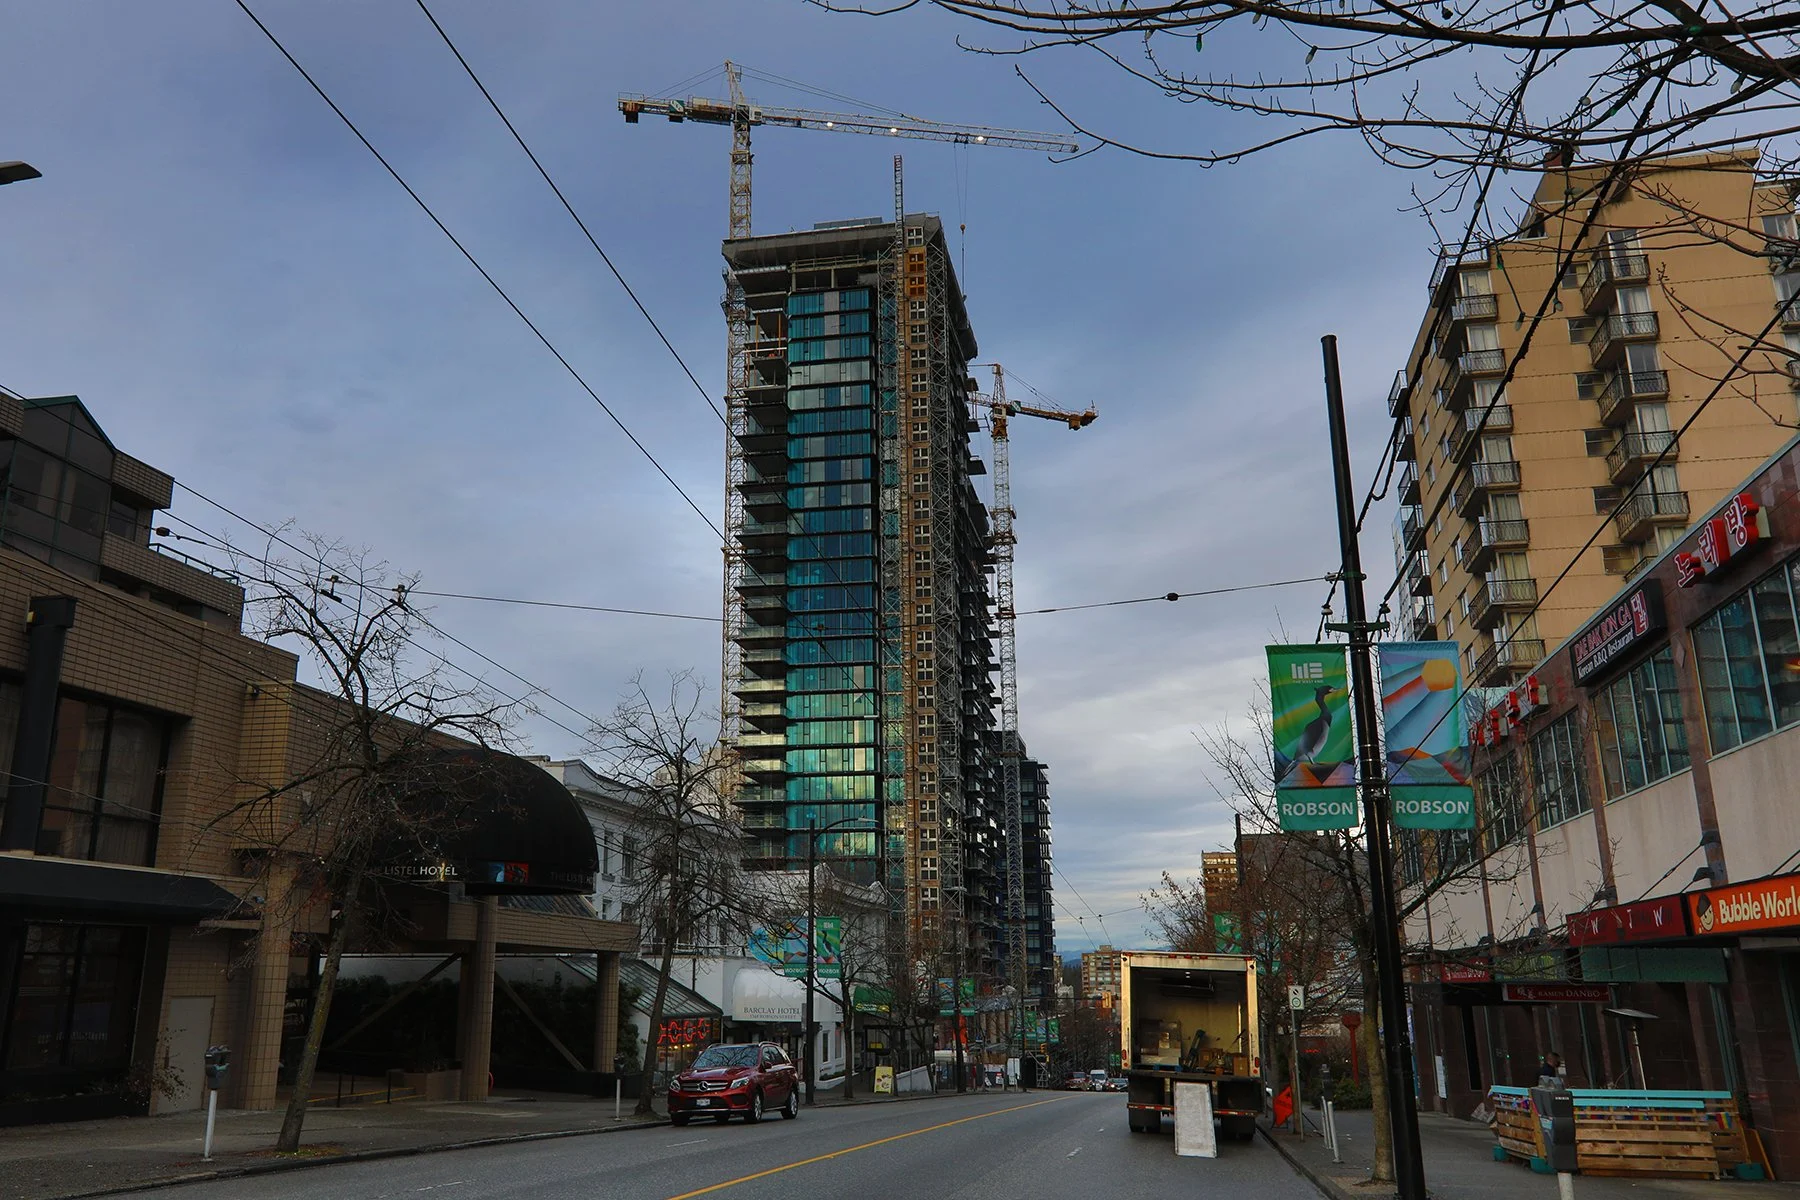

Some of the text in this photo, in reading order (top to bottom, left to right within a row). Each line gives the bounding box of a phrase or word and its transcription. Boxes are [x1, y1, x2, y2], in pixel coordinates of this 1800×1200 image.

[1673, 494, 1750, 588] 노래방
[1574, 638, 1588, 661] DAE
[1587, 628, 1602, 650] BAK
[1617, 603, 1632, 626] GA
[1577, 660, 1594, 680] Korean
[1608, 628, 1635, 657] Restaurant
[1282, 801, 1354, 817] ROBSON
[1395, 800, 1470, 815] ROBSON
[384, 866, 418, 876] LISTEL
[420, 866, 458, 876] HOTEL
[1719, 885, 1800, 924] Bubble Worl
[1566, 989, 1601, 998] DANBO
